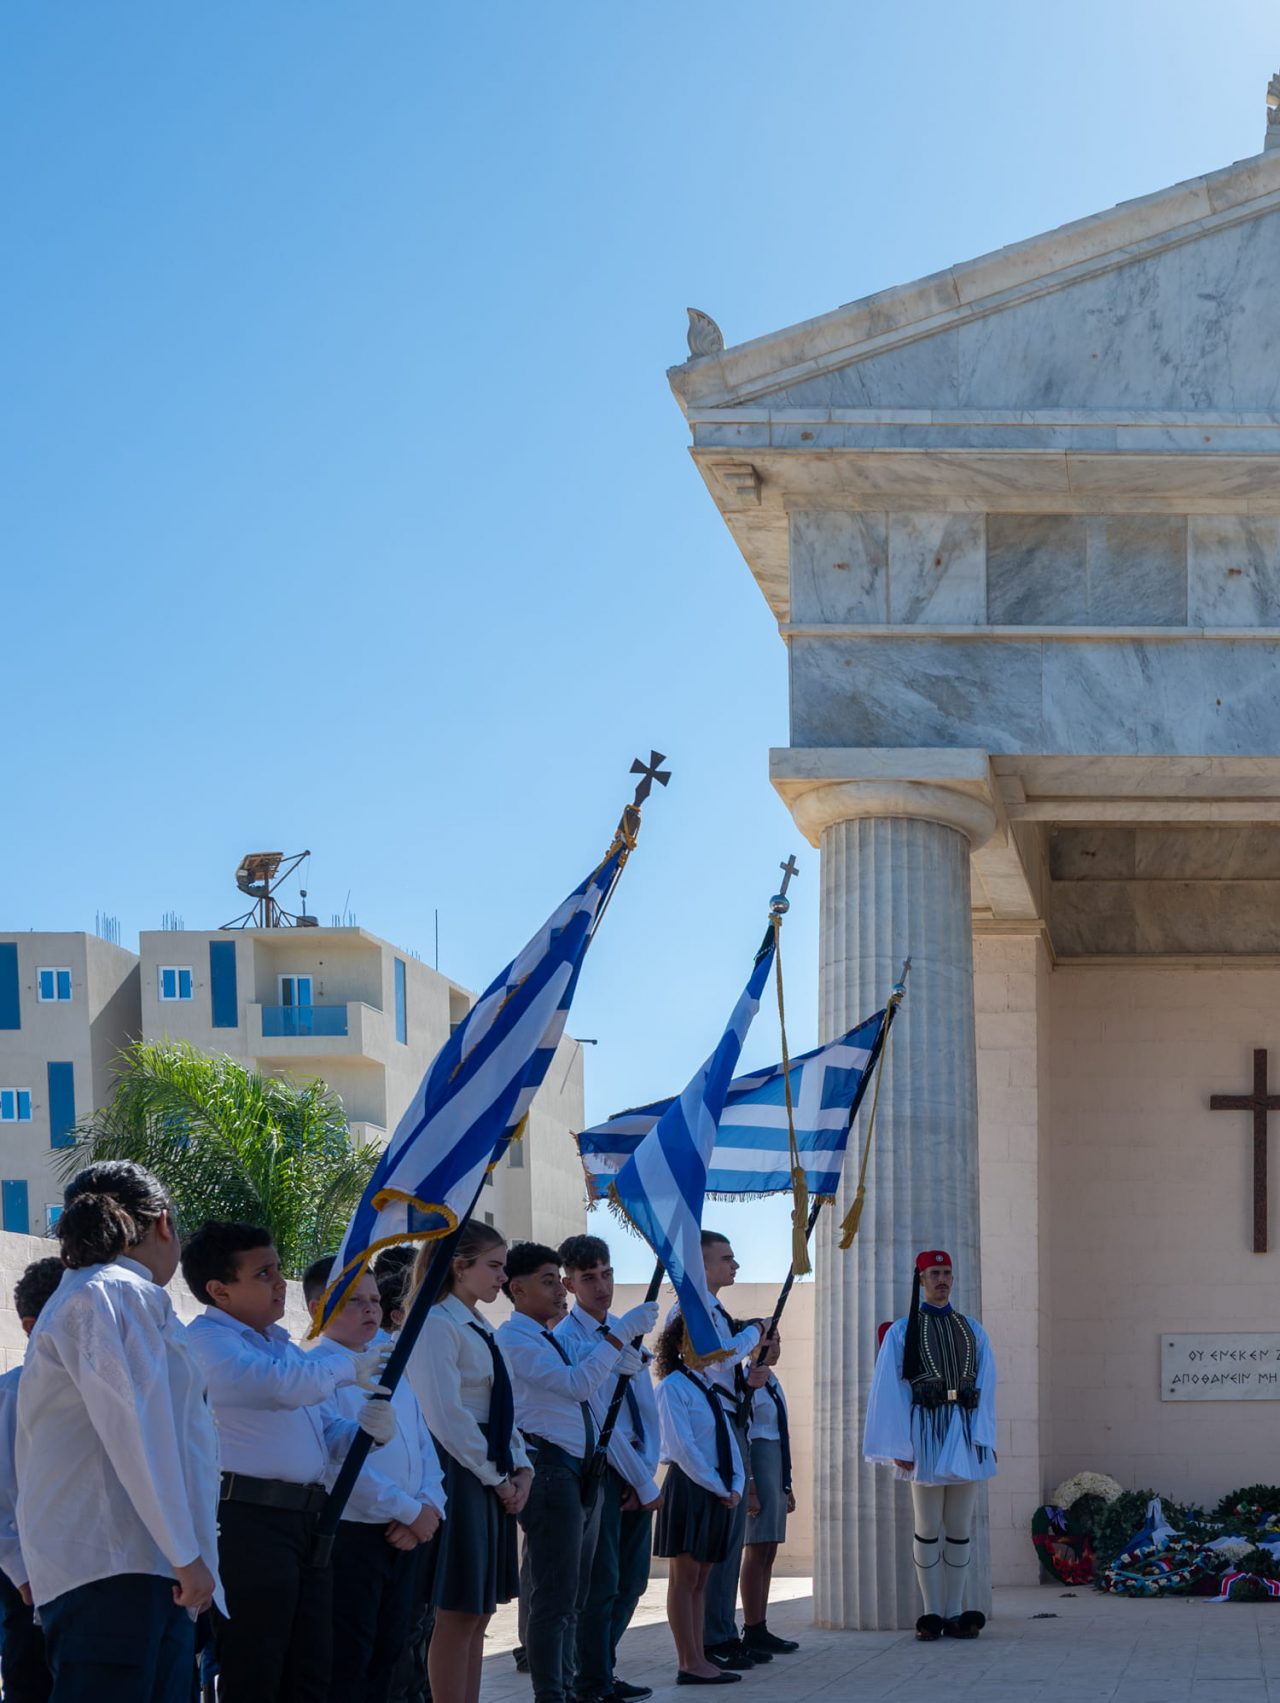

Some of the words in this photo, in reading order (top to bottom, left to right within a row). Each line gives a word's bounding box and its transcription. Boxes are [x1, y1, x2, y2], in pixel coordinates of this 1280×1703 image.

[1188, 1350, 1205, 1361] ΟΥ
[1210, 1350, 1269, 1361] ΕΝΕΚΕΝ
[1171, 1373, 1250, 1385] ΑΠΟΘΑΝΕΙΝ
[1258, 1372, 1277, 1384] ΜΗ
